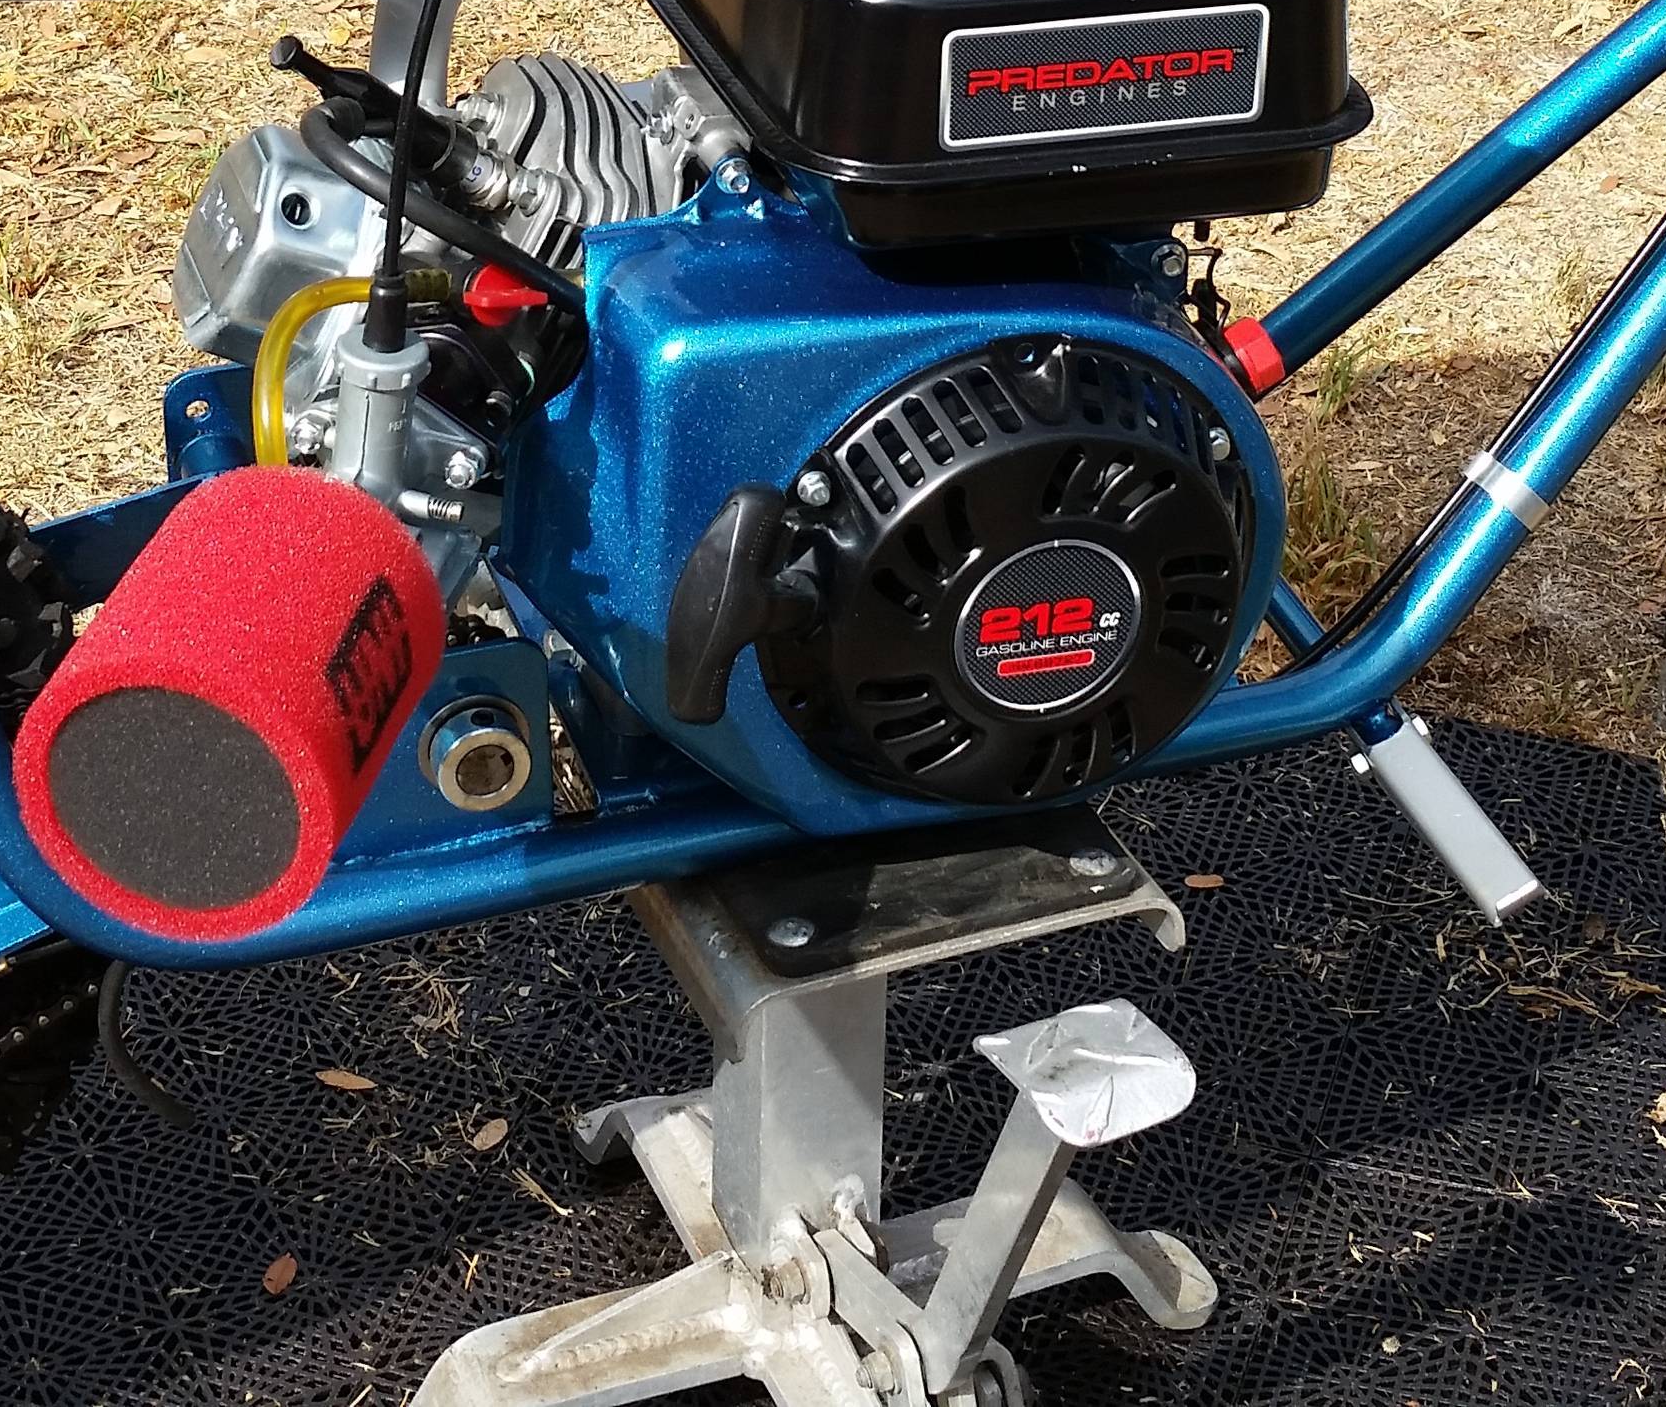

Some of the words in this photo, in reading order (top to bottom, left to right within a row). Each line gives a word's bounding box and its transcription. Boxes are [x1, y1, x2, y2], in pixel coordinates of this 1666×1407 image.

[968, 48, 1234, 96] PREDATOR
[1013, 80, 1187, 111] ENGINES
[979, 597, 1094, 642] 212
[976, 637, 1055, 657] GASOLINE
[1060, 630, 1118, 646] ENGINE
